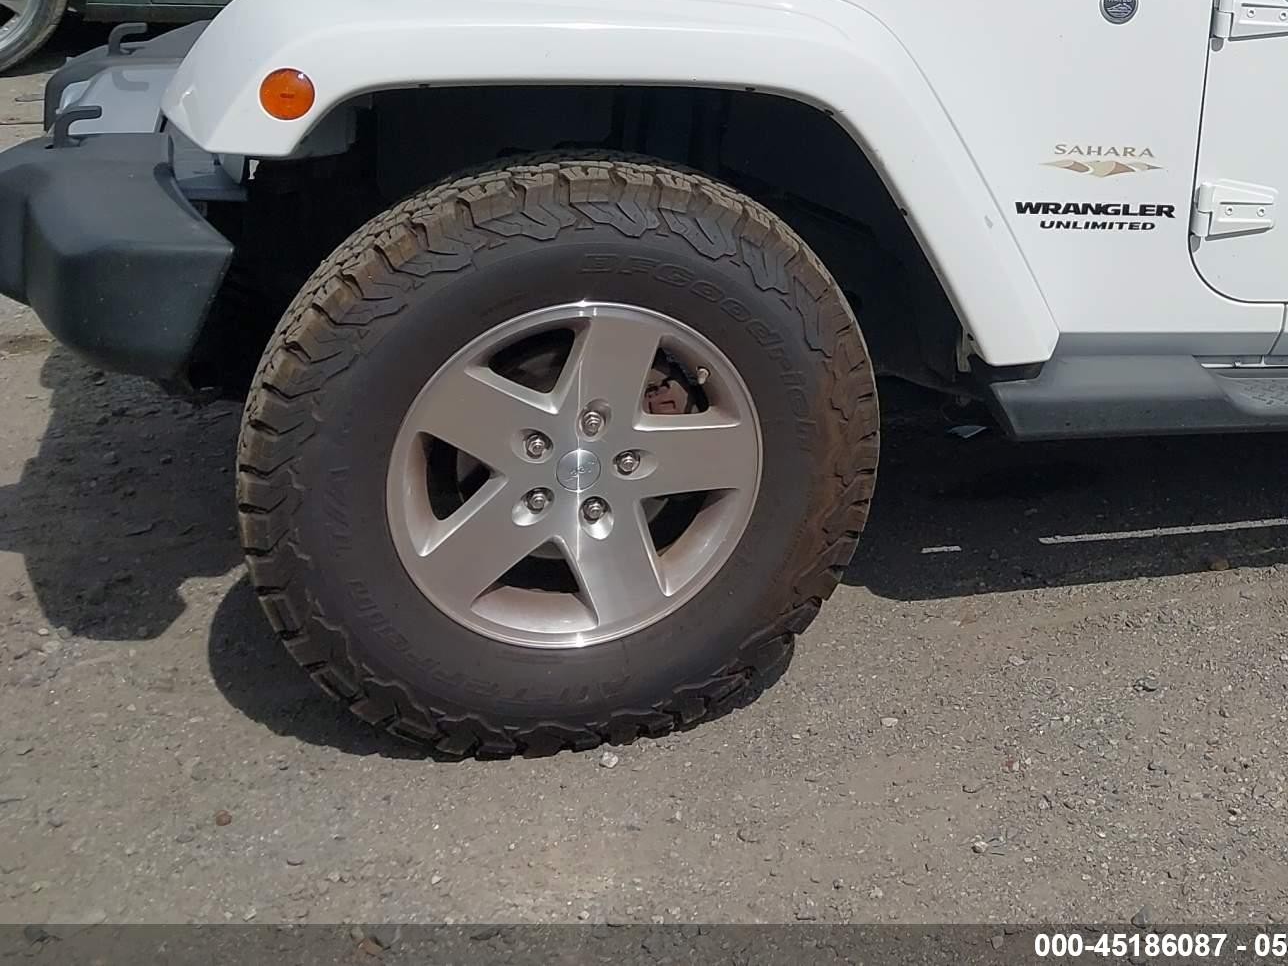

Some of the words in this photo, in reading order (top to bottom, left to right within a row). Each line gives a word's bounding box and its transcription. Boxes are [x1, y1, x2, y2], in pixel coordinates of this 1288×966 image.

[1054, 143, 1155, 158] SAHARA
[1015, 201, 1176, 218] WRANGLER
[1039, 219, 1156, 231] UNLIMITED
